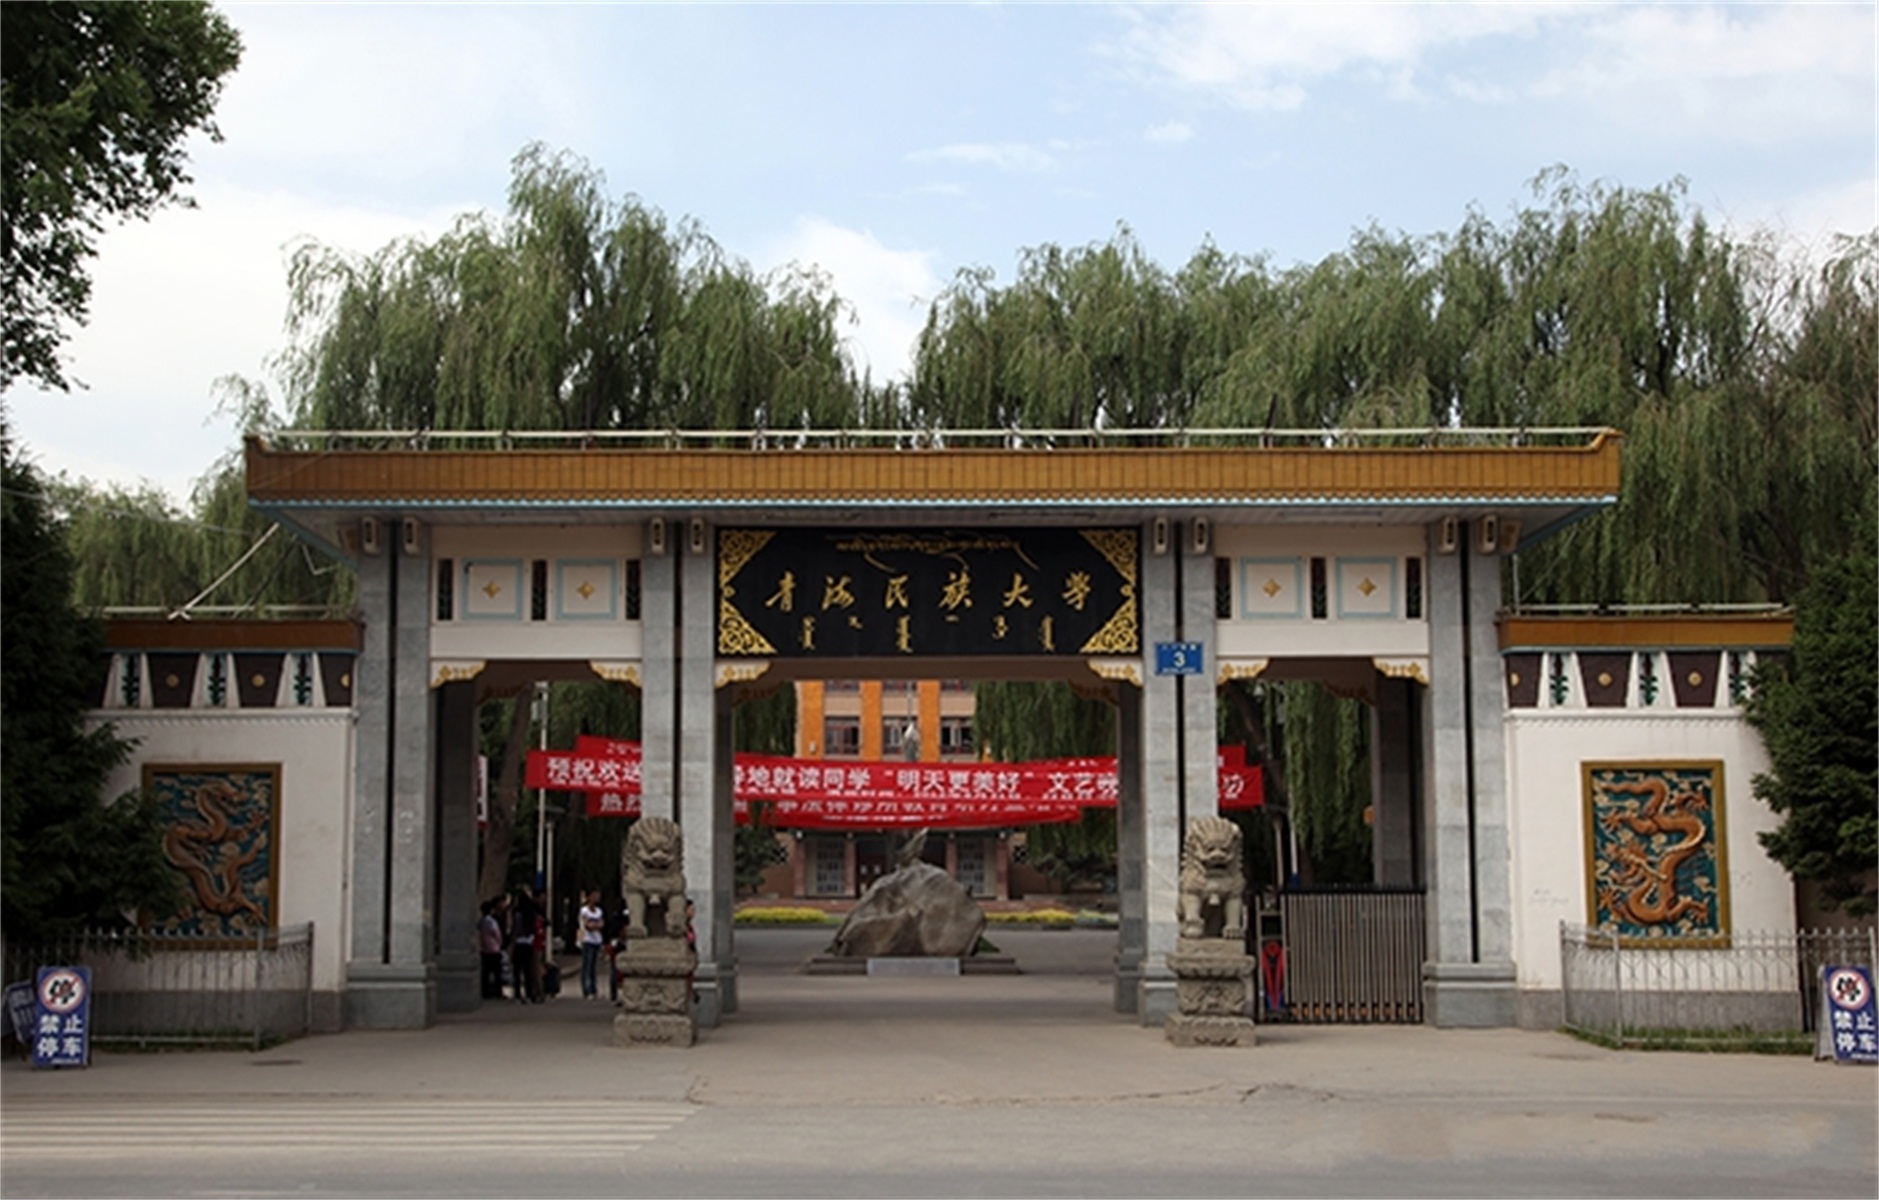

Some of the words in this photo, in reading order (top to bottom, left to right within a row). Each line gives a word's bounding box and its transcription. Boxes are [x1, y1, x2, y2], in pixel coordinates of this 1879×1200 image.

[1174, 651, 1187, 668] 3
[548, 757, 642, 783] 预祝欢送
[39, 1014, 83, 1034] 禁止
[1834, 1011, 1875, 1030] 禁止
[37, 1037, 82, 1057] 停车
[1836, 1032, 1878, 1052] 停车
